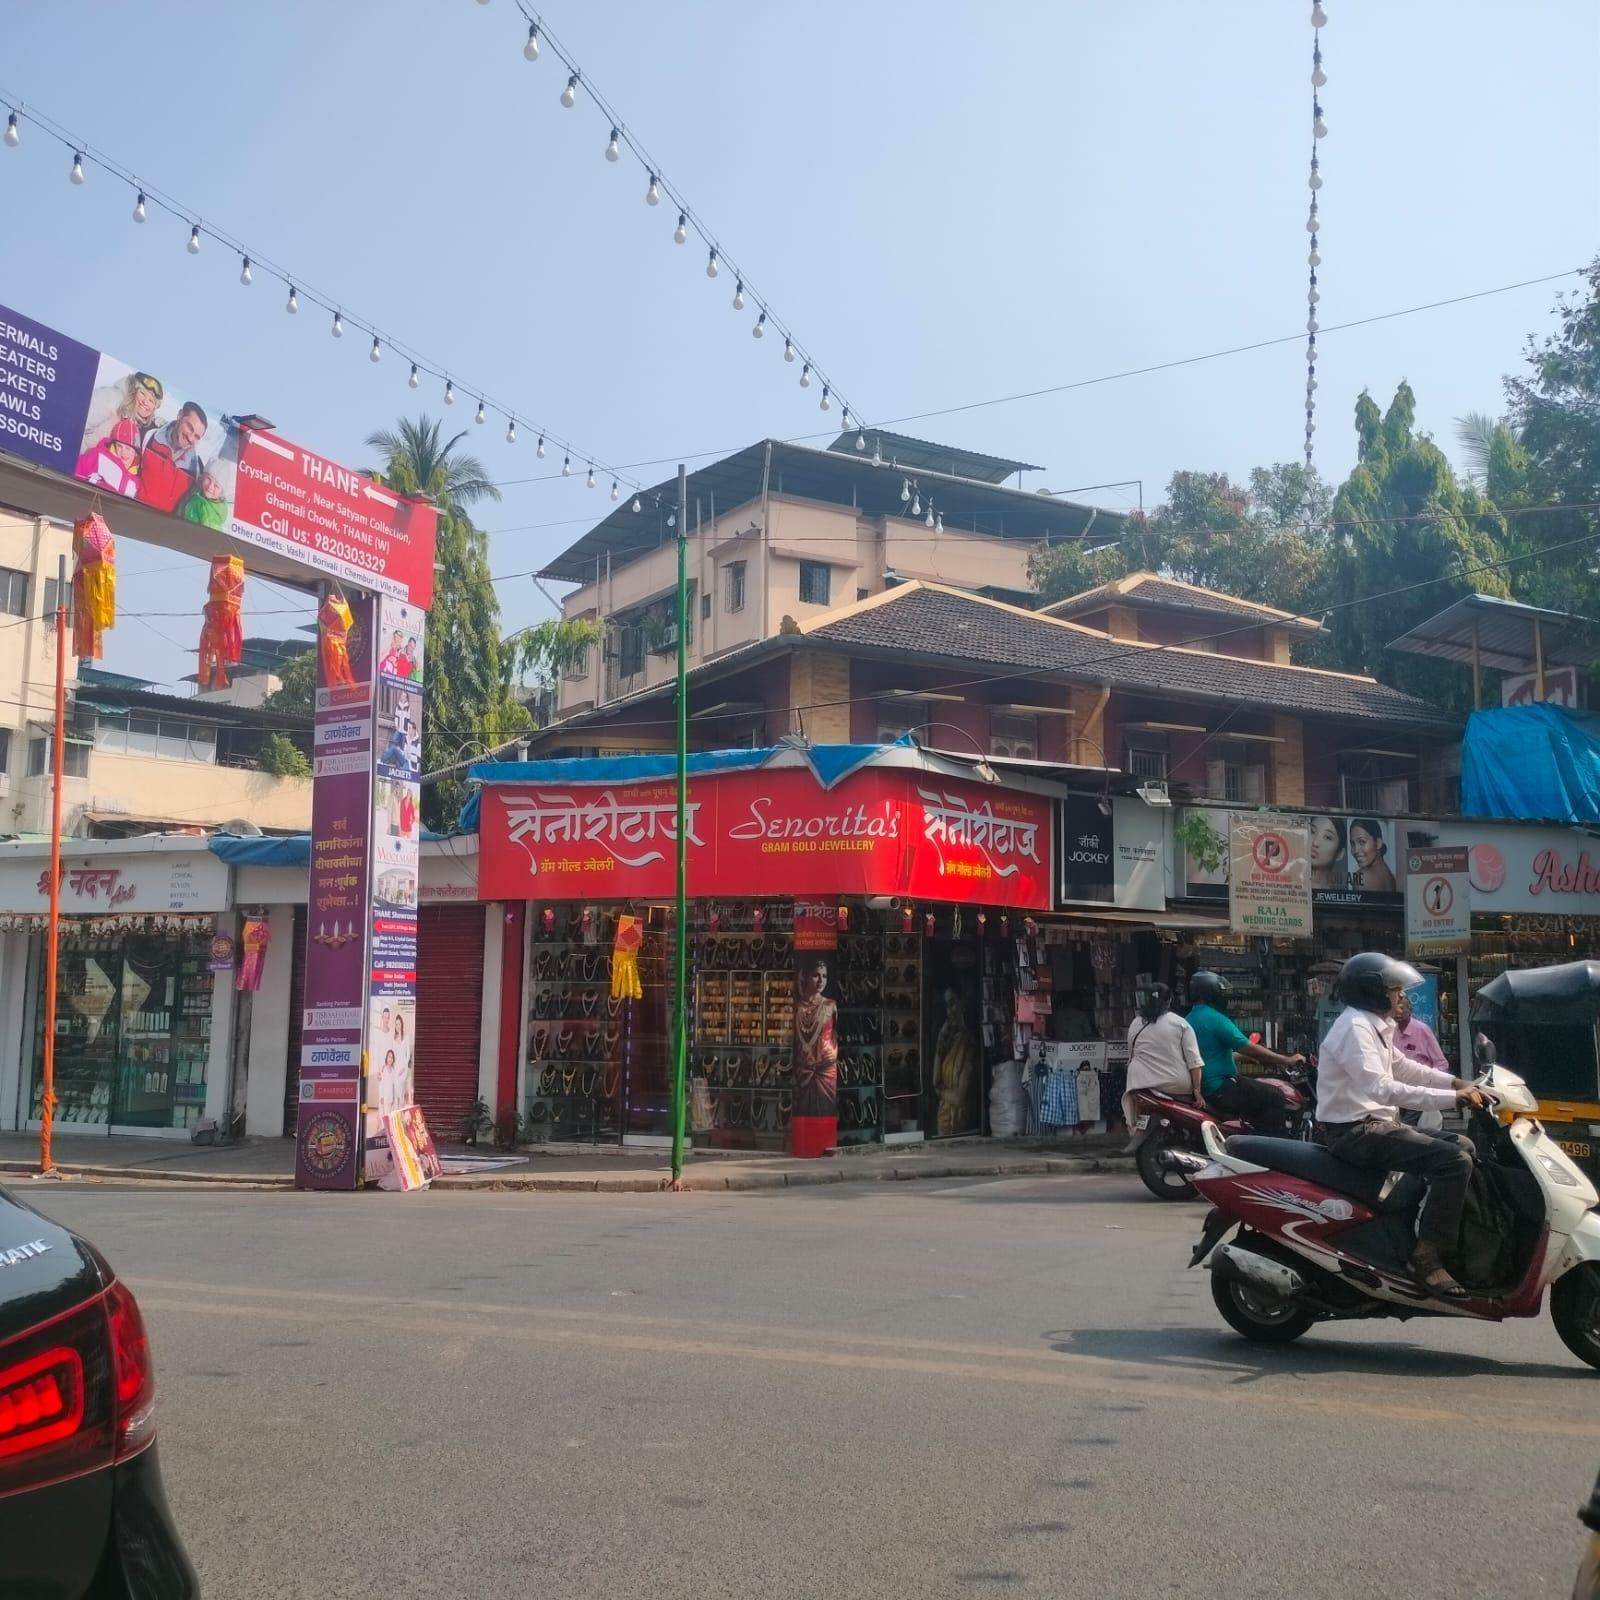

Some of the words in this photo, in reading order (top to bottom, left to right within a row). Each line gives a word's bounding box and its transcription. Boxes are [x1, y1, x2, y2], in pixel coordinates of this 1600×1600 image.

[302, 453, 359, 498] THANE
[239, 460, 272, 484] Crystal
[313, 492, 336, 510] Near
[336, 503, 368, 526] Satyam
[369, 517, 411, 545] Collection,
[265, 492, 305, 518] Ghantali
[307, 510, 340, 534] Chowk,
[342, 523, 373, 546] THANE
[375, 537, 390, 555] (W)
[231, 523, 254, 539] Other
[255, 533, 286, 551] Outlets:
[286, 544, 306, 559] Vashi
[260, 511, 289, 536] Call
[292, 527, 311, 545] us:
[315, 532, 386, 573] 9820303329
[388, 767, 412, 780] JACKETS
[728, 797, 901, 839] Senorita's
[762, 841, 790, 853] GRAM
[792, 840, 817, 852] GOLD
[818, 839, 875, 852] JEWELLERY
[558, 858, 581, 872] गोल्ड
[583, 857, 615, 871] ज्वेलरी
[1068, 850, 1110, 864] JOCKEY
[1315, 892, 1362, 902] JEWELLERY
[1257, 906, 1287, 916] RAJA
[1242, 914, 1277, 926] WEDDING
[1278, 917, 1303, 927] CARDS
[311, 1047, 351, 1062] ठाणेवैभव
[1069, 1044, 1096, 1052] JOCKEY
